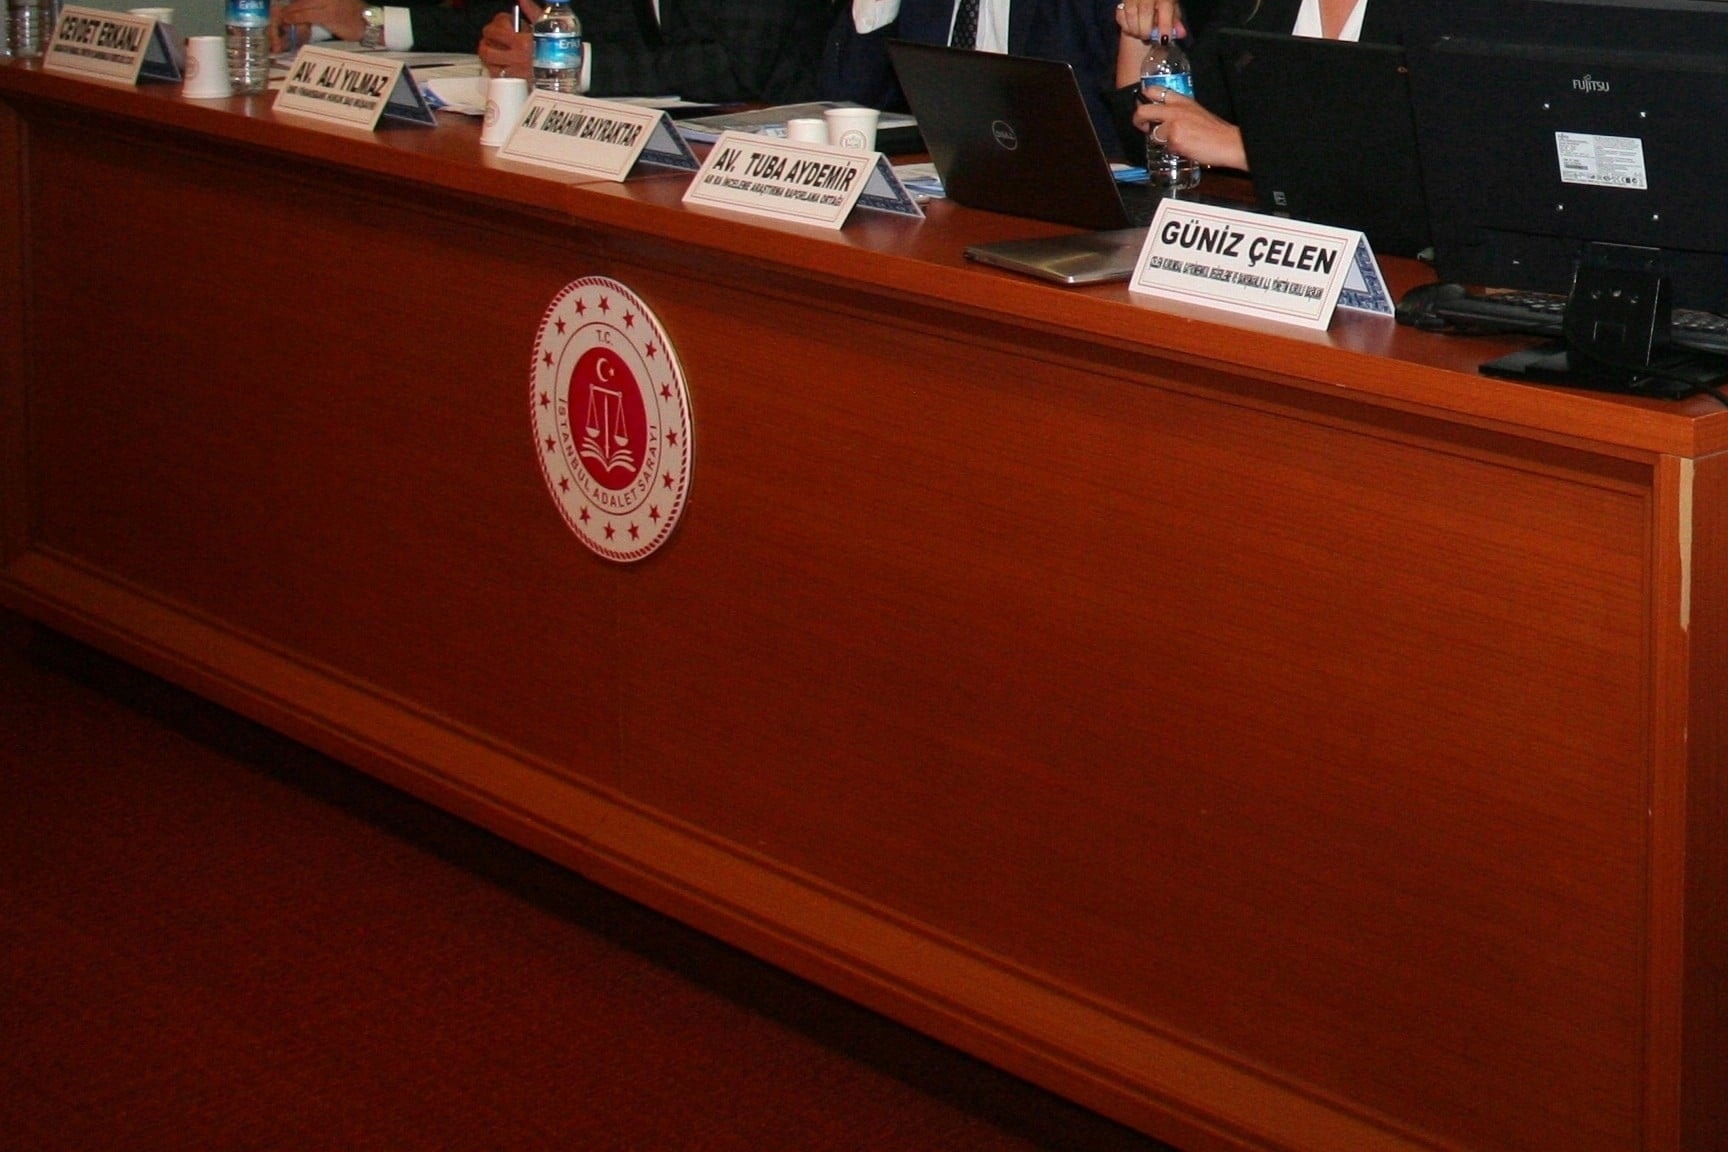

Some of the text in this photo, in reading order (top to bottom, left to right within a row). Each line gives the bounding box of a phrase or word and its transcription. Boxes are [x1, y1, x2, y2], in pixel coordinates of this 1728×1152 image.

[294, 61, 389, 97] AV. ALİ YILMAZ
[1572, 74, 1610, 93] FUJITSU
[521, 103, 643, 148] AV. İBRAHİM BAYRAKTAR
[712, 148, 858, 192] AV. TUBA AYDEMİR
[1161, 219, 1339, 275] GÜNİZ ÇELEN
[595, 329, 614, 346] T.C.
[592, 486, 639, 509] ADALET
[638, 425, 657, 491] SARAYI
